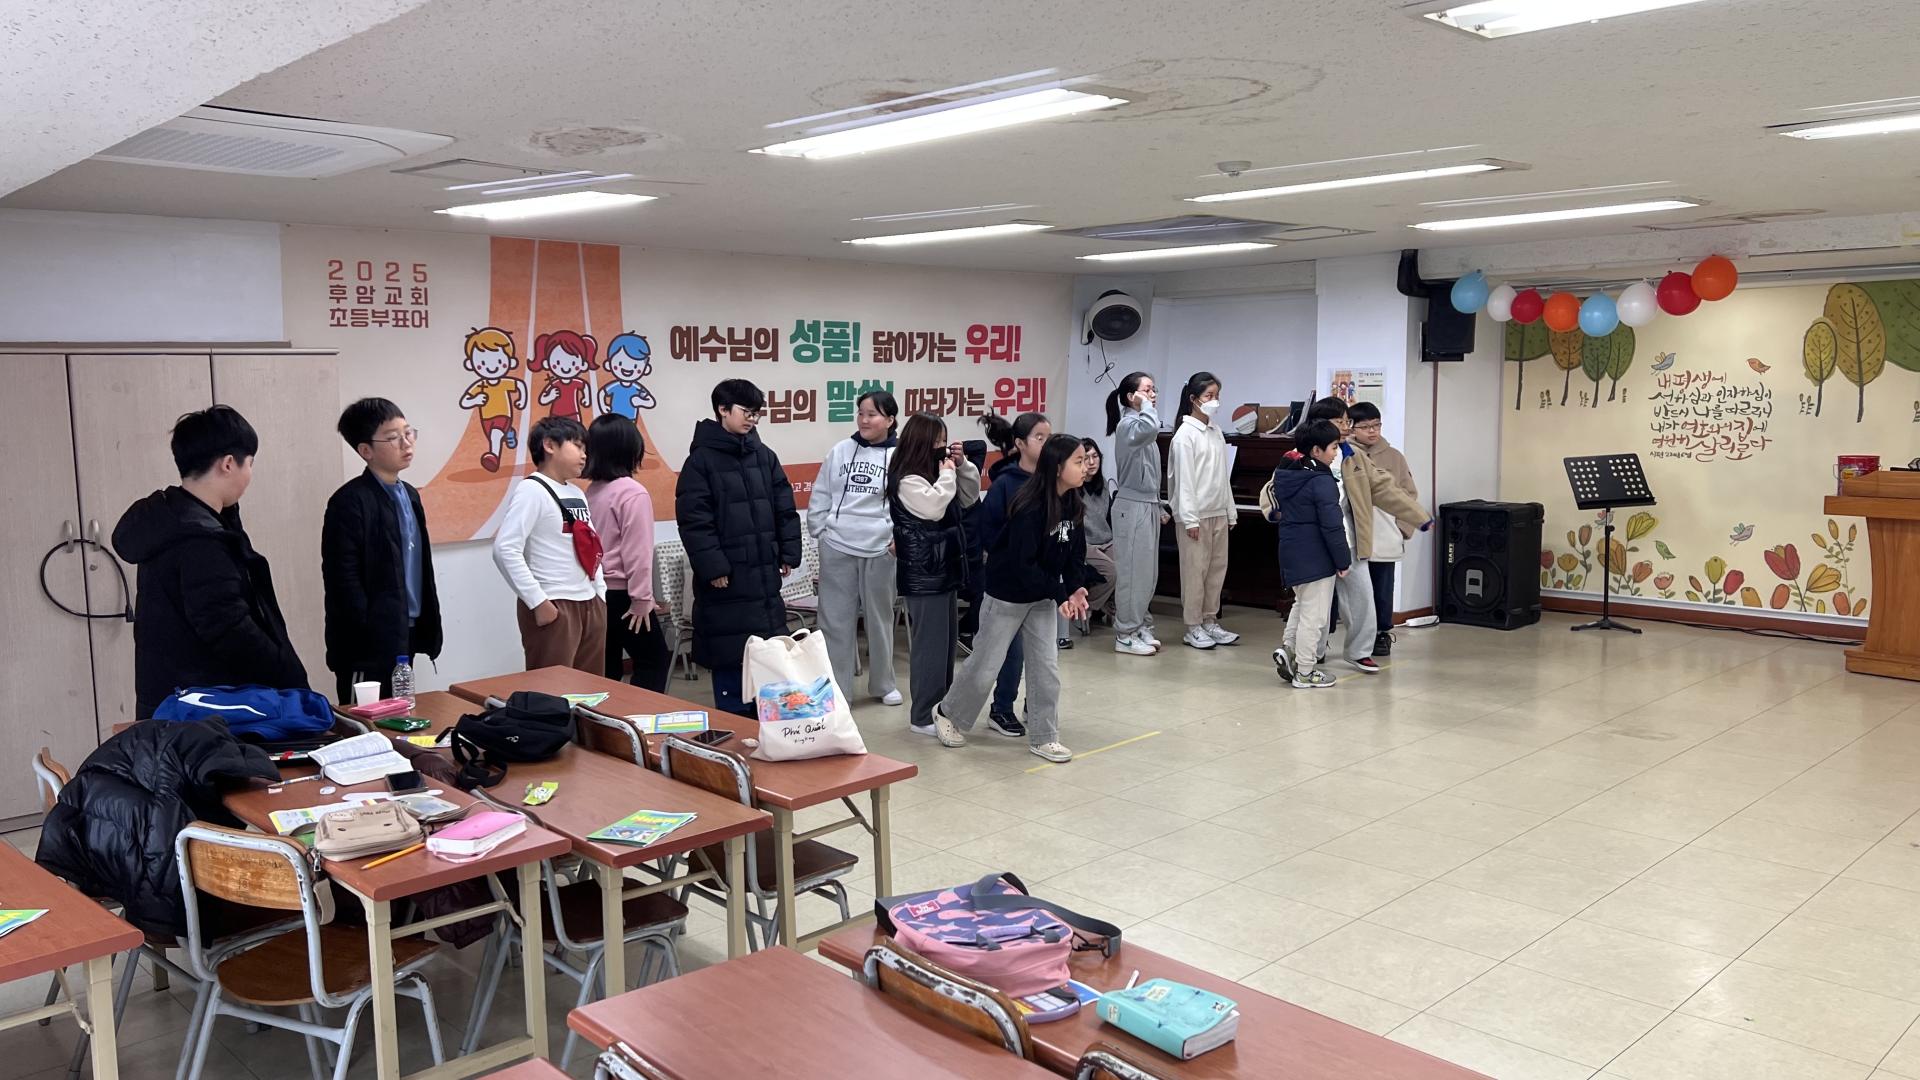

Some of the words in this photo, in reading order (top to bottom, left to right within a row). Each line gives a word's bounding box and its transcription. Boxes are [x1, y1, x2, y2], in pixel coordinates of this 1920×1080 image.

[328, 260, 427, 283] 2025
[329, 284, 428, 306] 후암교회
[329, 307, 429, 328] 초등부표어
[670, 325, 779, 362] 예수님의
[790, 319, 861, 363] 성품!
[873, 331, 957, 363] 닮아가는
[965, 324, 1021, 364] 우리!
[1648, 387, 1713, 406] 선하심과
[1716, 381, 1772, 404] 인자하심이
[1658, 373, 1671, 389] 내
[1672, 370, 1727, 394] 평생에
[757, 389, 817, 423] 님의
[905, 387, 985, 417] 따라가는
[992, 377, 1047, 416] 우리!
[1654, 404, 1689, 420] 반드시
[1693, 404, 1724, 420] 나를
[1725, 401, 1773, 418] 따르리니
[1651, 420, 1680, 433] 내가
[1681, 419, 1732, 438] 여호와의
[1733, 417, 1768, 442] 집에
[1651, 433, 1690, 448] 영원히
[1685, 436, 1773, 462] 살리로다
